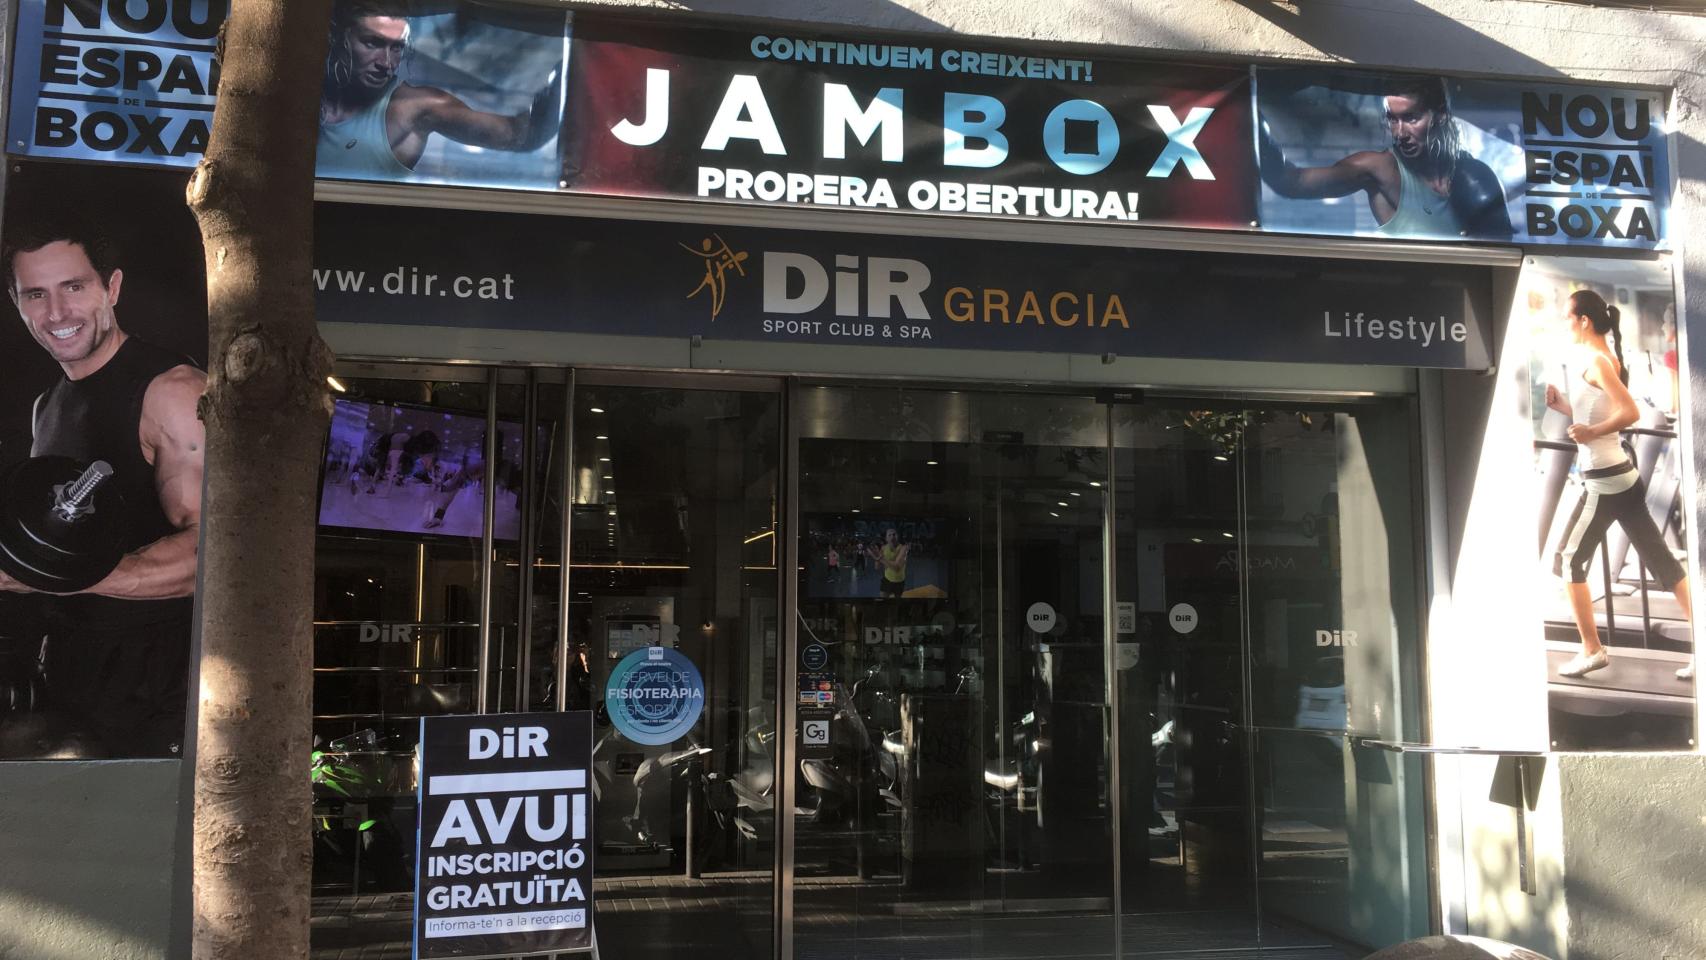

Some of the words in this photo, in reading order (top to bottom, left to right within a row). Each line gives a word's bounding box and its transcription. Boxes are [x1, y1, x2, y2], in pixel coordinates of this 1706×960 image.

[44, 0, 229, 40] NOU
[751, 35, 933, 71] CONTINUEM
[940, 49, 1094, 82] CREIXENT!
[124, 97, 140, 106] DE
[1522, 92, 1651, 141] NOU
[34, 106, 211, 157] BOXA
[610, 68, 1216, 181] JAMBOX
[1525, 150, 1655, 188] ESPAI
[698, 166, 898, 209] PROPERA
[908, 181, 1139, 220] OBERTURA!
[1525, 203, 1656, 242] BOXA
[763, 251, 932, 321] DiR
[944, 286, 1130, 328] GRACIA
[763, 320, 820, 334] SPORT
[828, 323, 874, 337] CLUB
[881, 325, 893, 338] &
[899, 326, 932, 339] SPA
[1323, 311, 1468, 345] Lifestyle
[359, 623, 413, 643] DiR
[865, 627, 911, 644] DiR
[1175, 614, 1192, 622] DiR
[1315, 629, 1358, 647] DiR
[607, 685, 702, 699] FISIOTERÀPIA
[672, 671, 690, 683] DE
[468, 726, 549, 760] DiR
[430, 794, 587, 848] AVUI
[428, 843, 585, 877] INSCRIPCIÓ
[427, 873, 585, 910] GRATUÏTA
[429, 918, 503, 932] Informa-te'n
[506, 919, 513, 927] a
[517, 915, 527, 926] la
[531, 911, 582, 927] recepció
